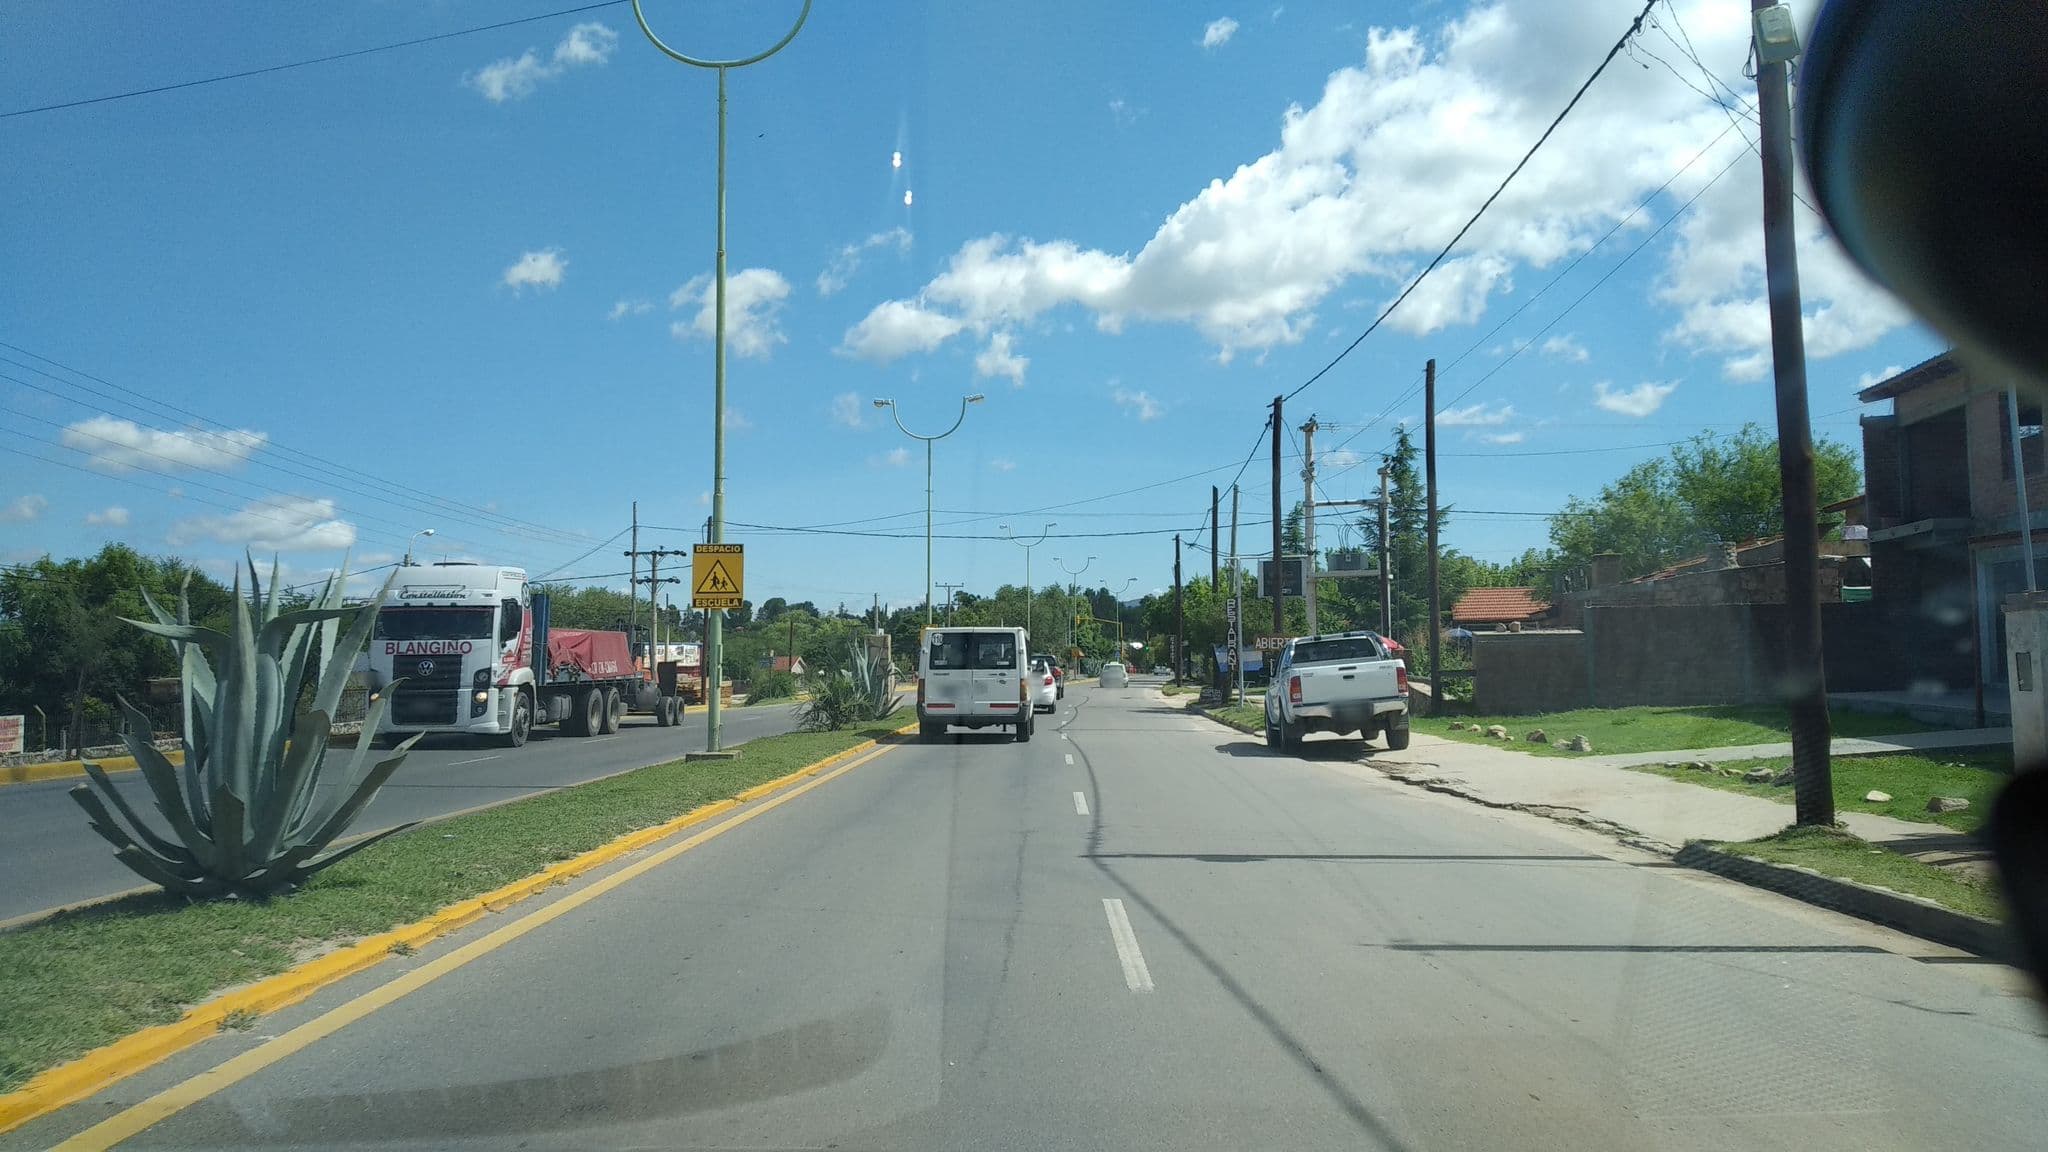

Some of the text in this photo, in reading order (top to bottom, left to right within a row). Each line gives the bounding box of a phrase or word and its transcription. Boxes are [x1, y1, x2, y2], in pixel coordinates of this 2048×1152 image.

[696, 545, 741, 553] DESPACIO
[400, 590, 466, 599] Constellation
[695, 598, 740, 607] ESCUELA
[1226, 598, 1237, 670] RESTAURANT
[385, 641, 473, 655] BLANGINO
[1255, 636, 1292, 649] ABIERT
